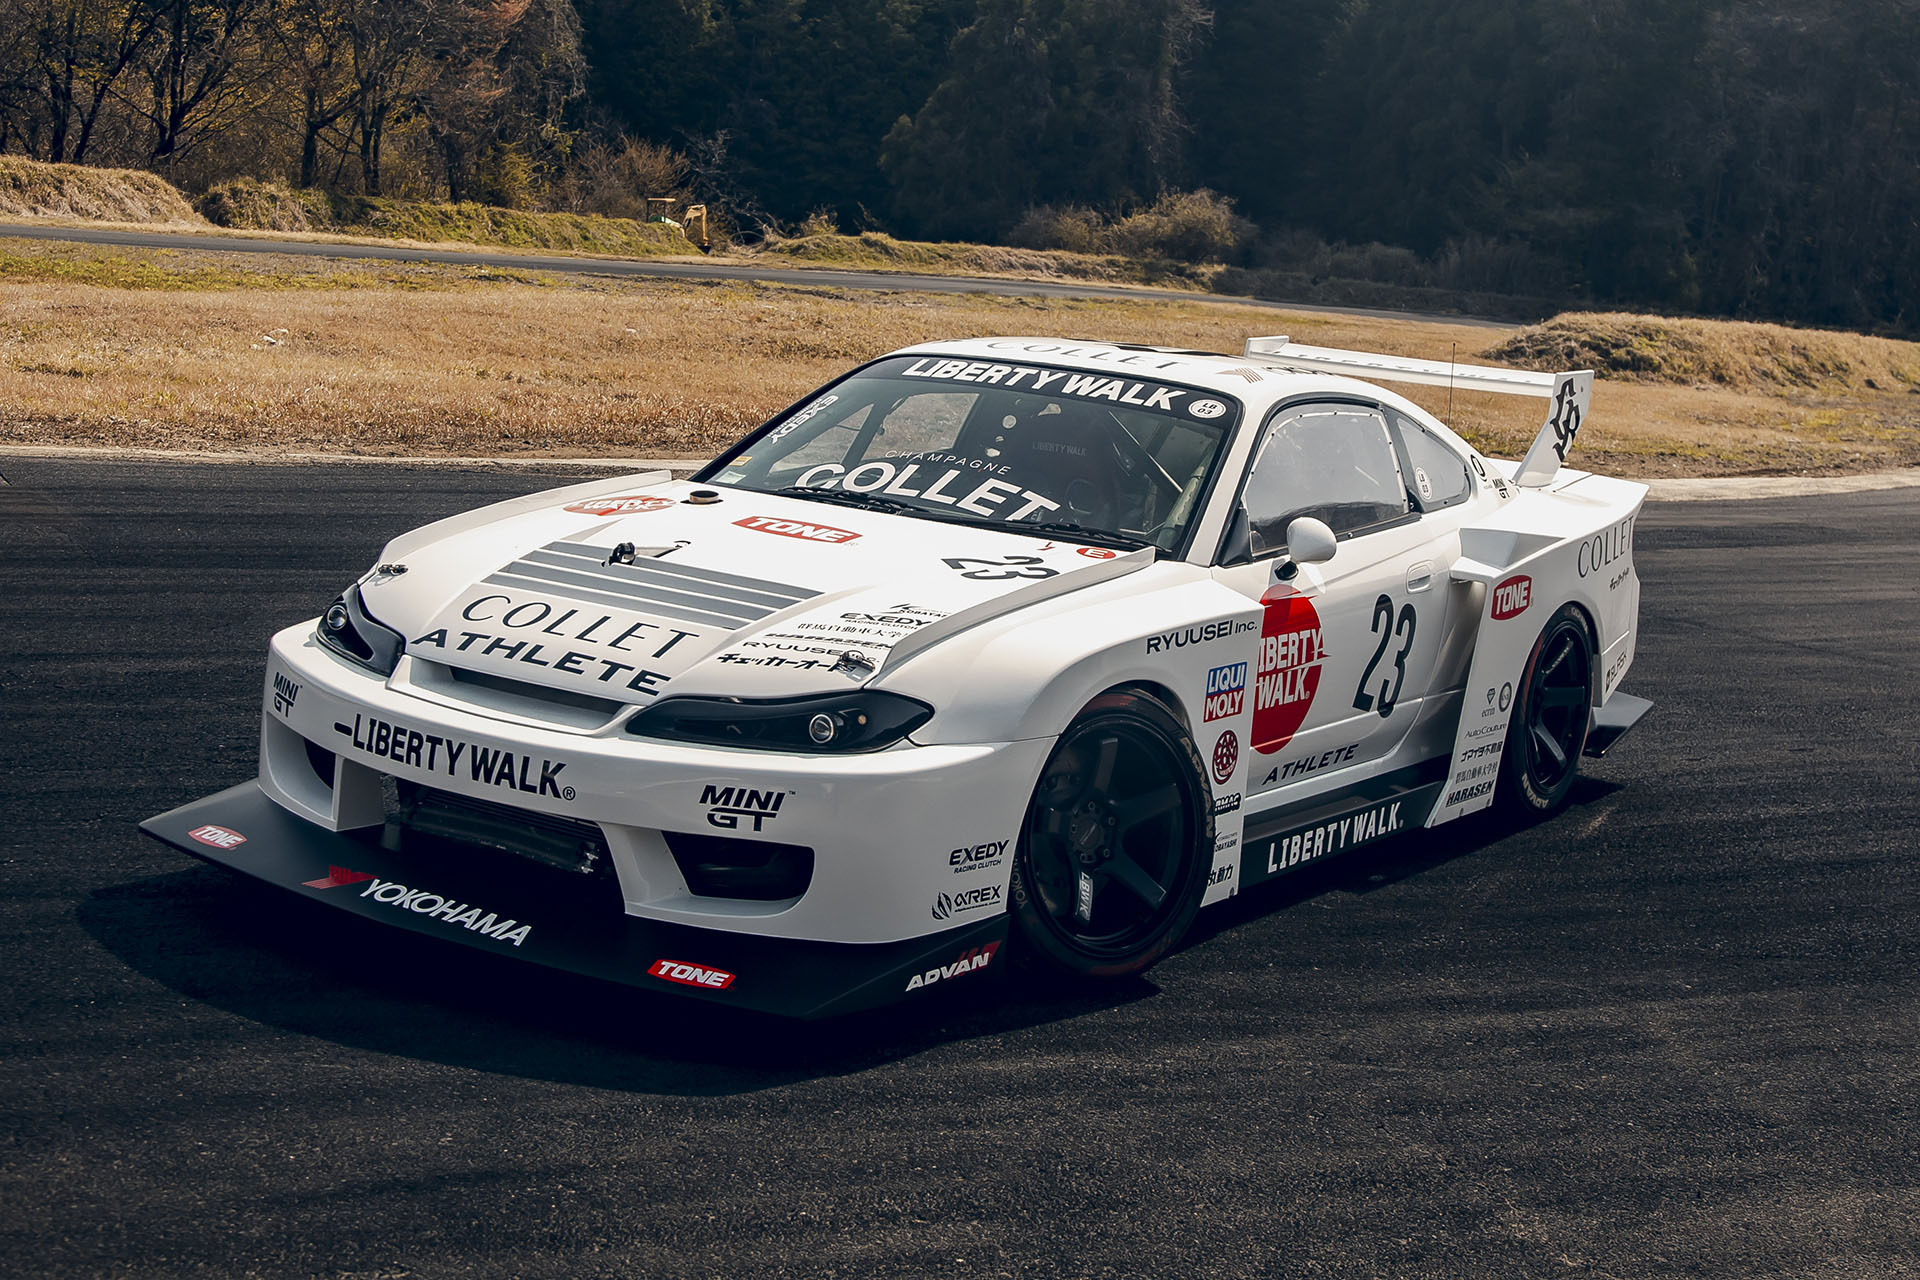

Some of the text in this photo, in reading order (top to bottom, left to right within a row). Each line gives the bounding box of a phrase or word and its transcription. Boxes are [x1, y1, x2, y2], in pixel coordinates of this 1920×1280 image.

[987, 342, 1189, 370] COLLET
[901, 358, 1187, 411] LIBERTY WALK
[1197, 407, 1213, 415] 03
[1202, 402, 1218, 410] LB
[884, 450, 1012, 475] CHAMPAGNE
[794, 461, 1061, 521] COLLET
[747, 518, 854, 542] TONE
[1578, 515, 1634, 578] COLLET
[1495, 580, 1529, 615] TONE
[461, 595, 701, 659] COLLET
[840, 612, 932, 626] EXEDY
[1146, 619, 1234, 655] RYUUSEI
[1258, 627, 1325, 673] IBERTY
[412, 628, 672, 697] ATHLETE
[1352, 593, 1417, 718] 23
[273, 671, 299, 702] MINI
[1208, 663, 1246, 694] LIQUI
[273, 692, 294, 718] GT
[1205, 689, 1244, 721] MOLY
[1261, 743, 1360, 786] ATHLETE
[699, 784, 786, 812] MINI
[1445, 779, 1495, 807] HARASEN
[706, 807, 778, 832] GT
[195, 826, 243, 847] TONE
[1267, 816, 1351, 875] LIBERTY
[949, 839, 1010, 866] EXEDY
[953, 859, 1002, 874] RACING CLUTCH
[360, 878, 532, 947] YOKOHAMA
[658, 961, 730, 987] TONE
[905, 952, 990, 992] ADVAN
